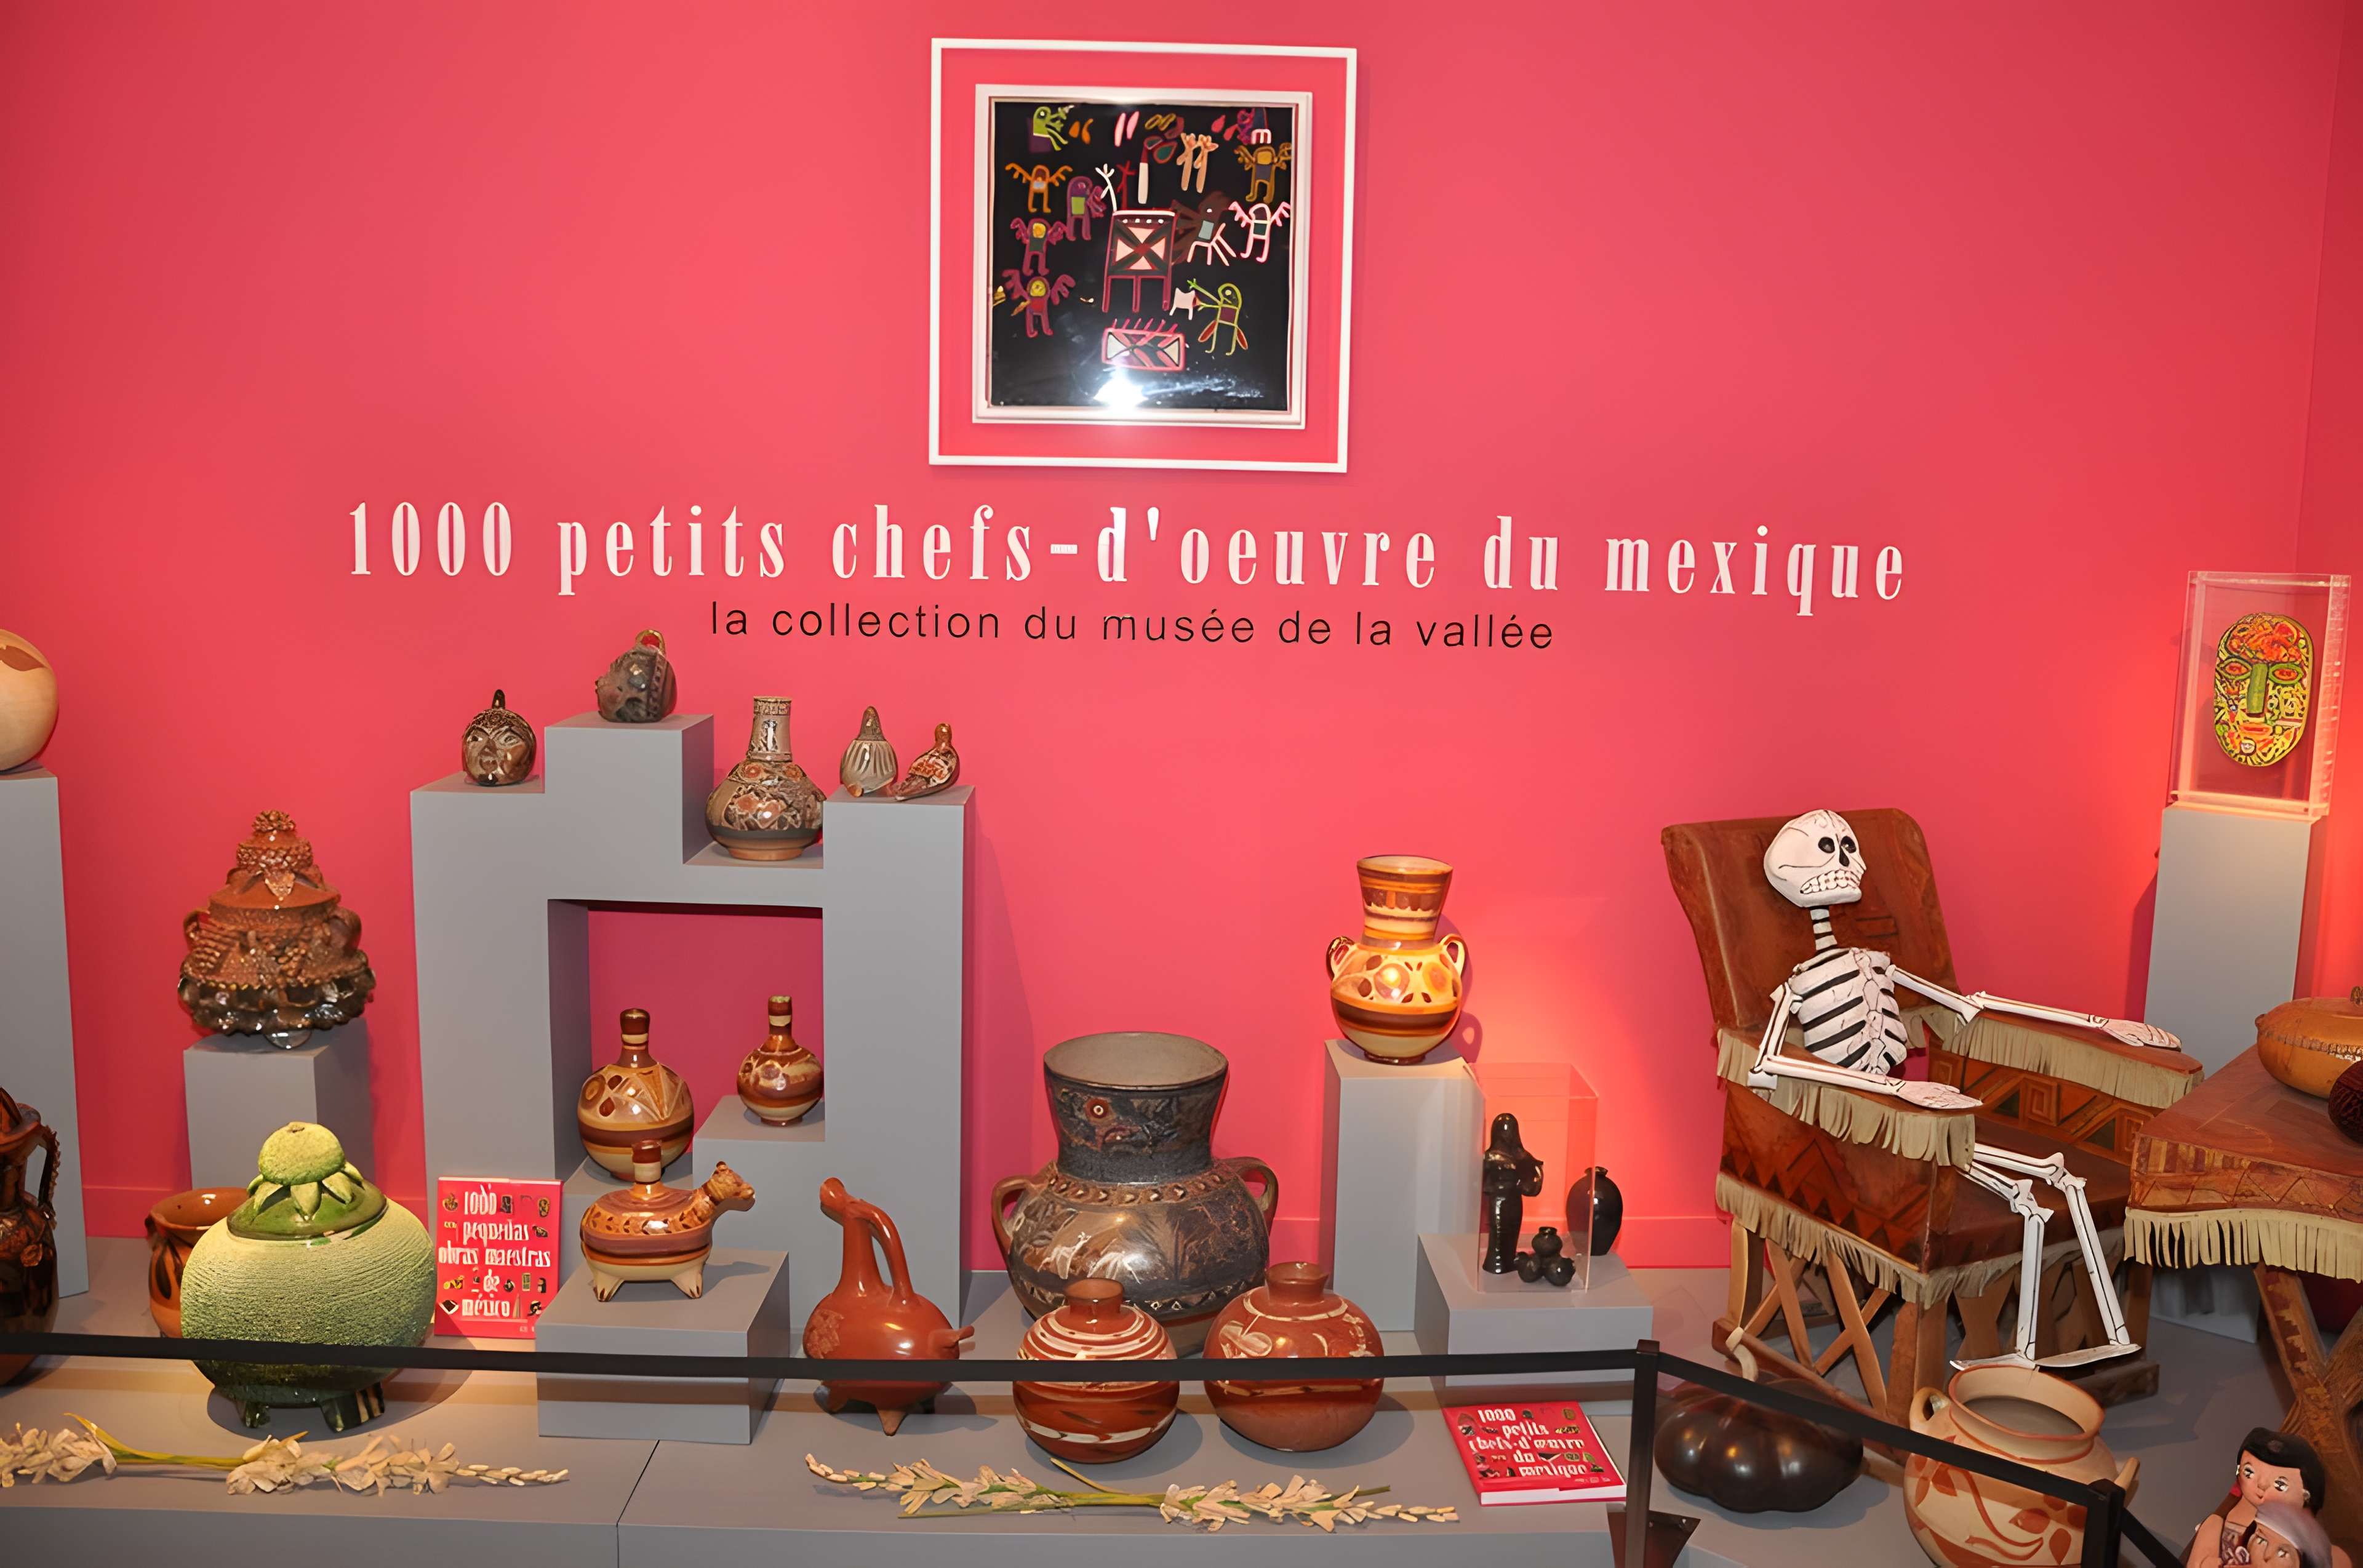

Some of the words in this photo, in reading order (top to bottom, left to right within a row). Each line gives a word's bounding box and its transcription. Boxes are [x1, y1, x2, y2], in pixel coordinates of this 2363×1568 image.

[349, 502, 512, 577] 1000
[557, 505, 785, 596] petits
[832, 503, 1435, 589] chefs-d'oeuvre
[1483, 514, 1559, 591] du
[1604, 524, 1908, 617] mexique
[712, 601, 748, 636] la
[772, 602, 999, 639] collection
[1024, 605, 1076, 641] du
[1103, 608, 1255, 644] musée
[1278, 609, 1331, 645] de
[1356, 610, 1391, 646] la
[1415, 614, 1553, 650] vallée
